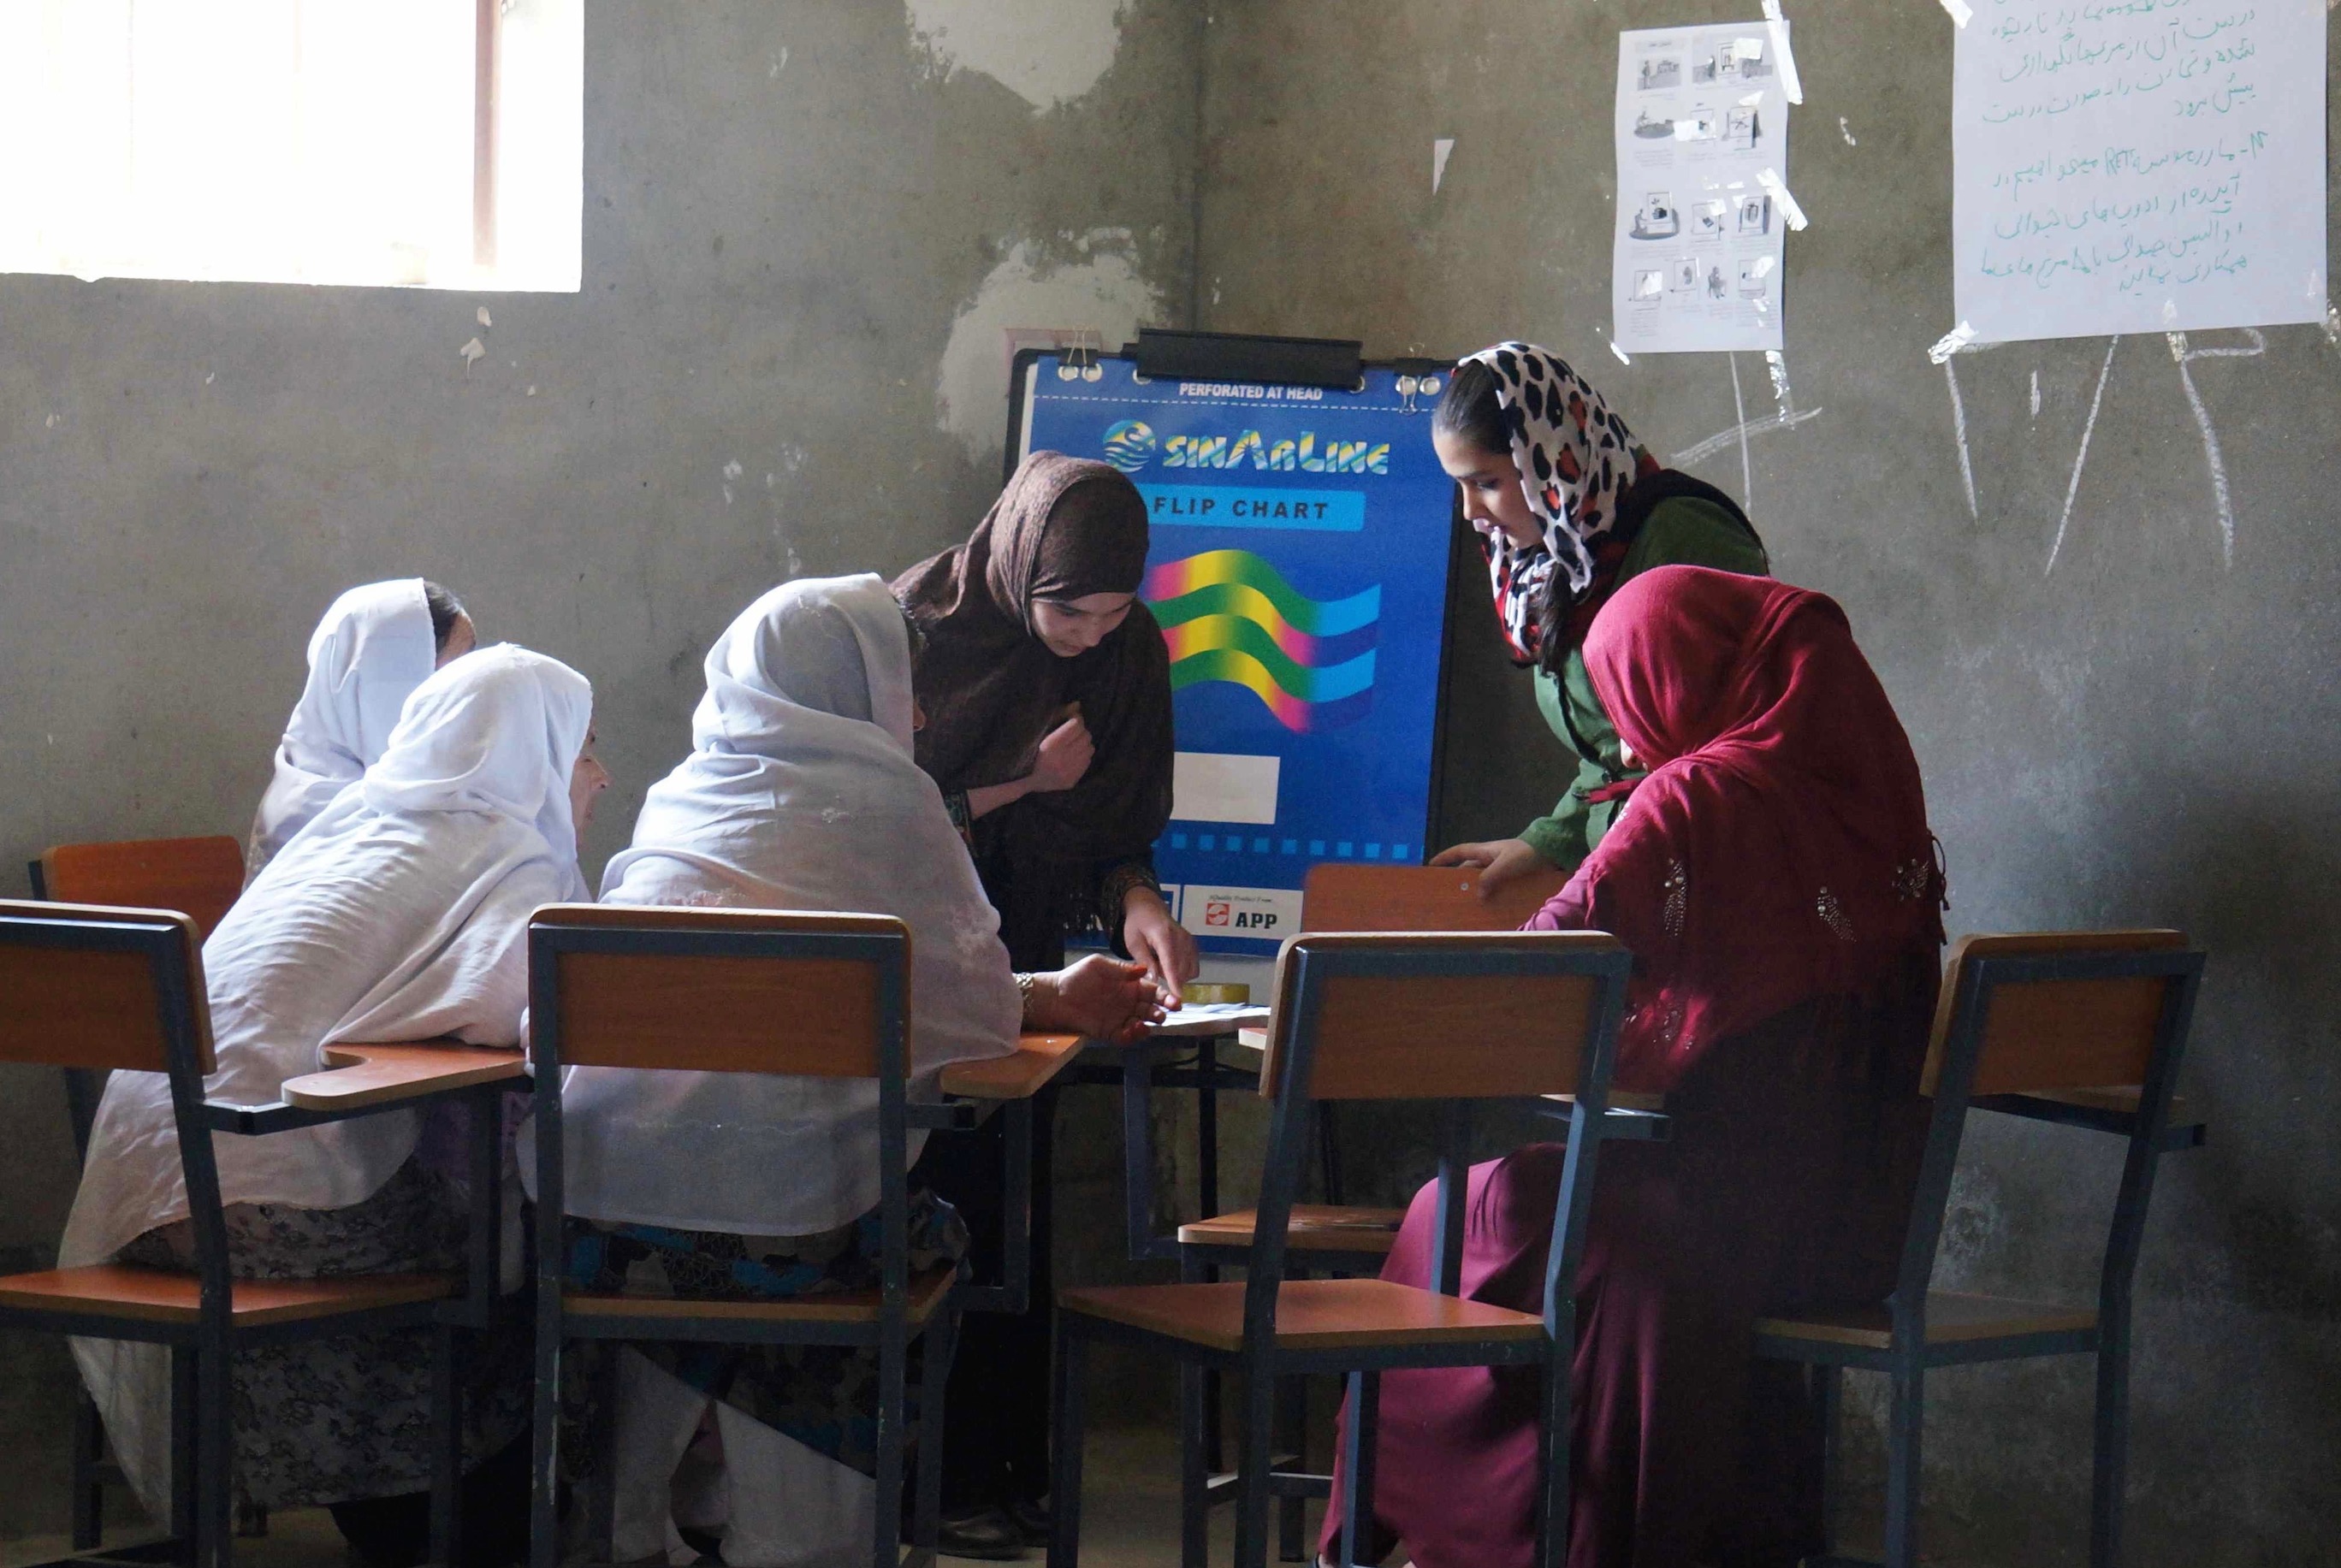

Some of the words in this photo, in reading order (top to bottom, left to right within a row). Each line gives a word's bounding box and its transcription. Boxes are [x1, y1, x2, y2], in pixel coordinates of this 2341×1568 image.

[1178, 382, 1264, 399] PERFORATED
[1266, 386, 1285, 399] AT
[1286, 387, 1324, 401] HEAD
[1153, 496, 1217, 515] FLIP
[1231, 500, 1330, 519] CHART
[1235, 912, 1277, 930] APP
